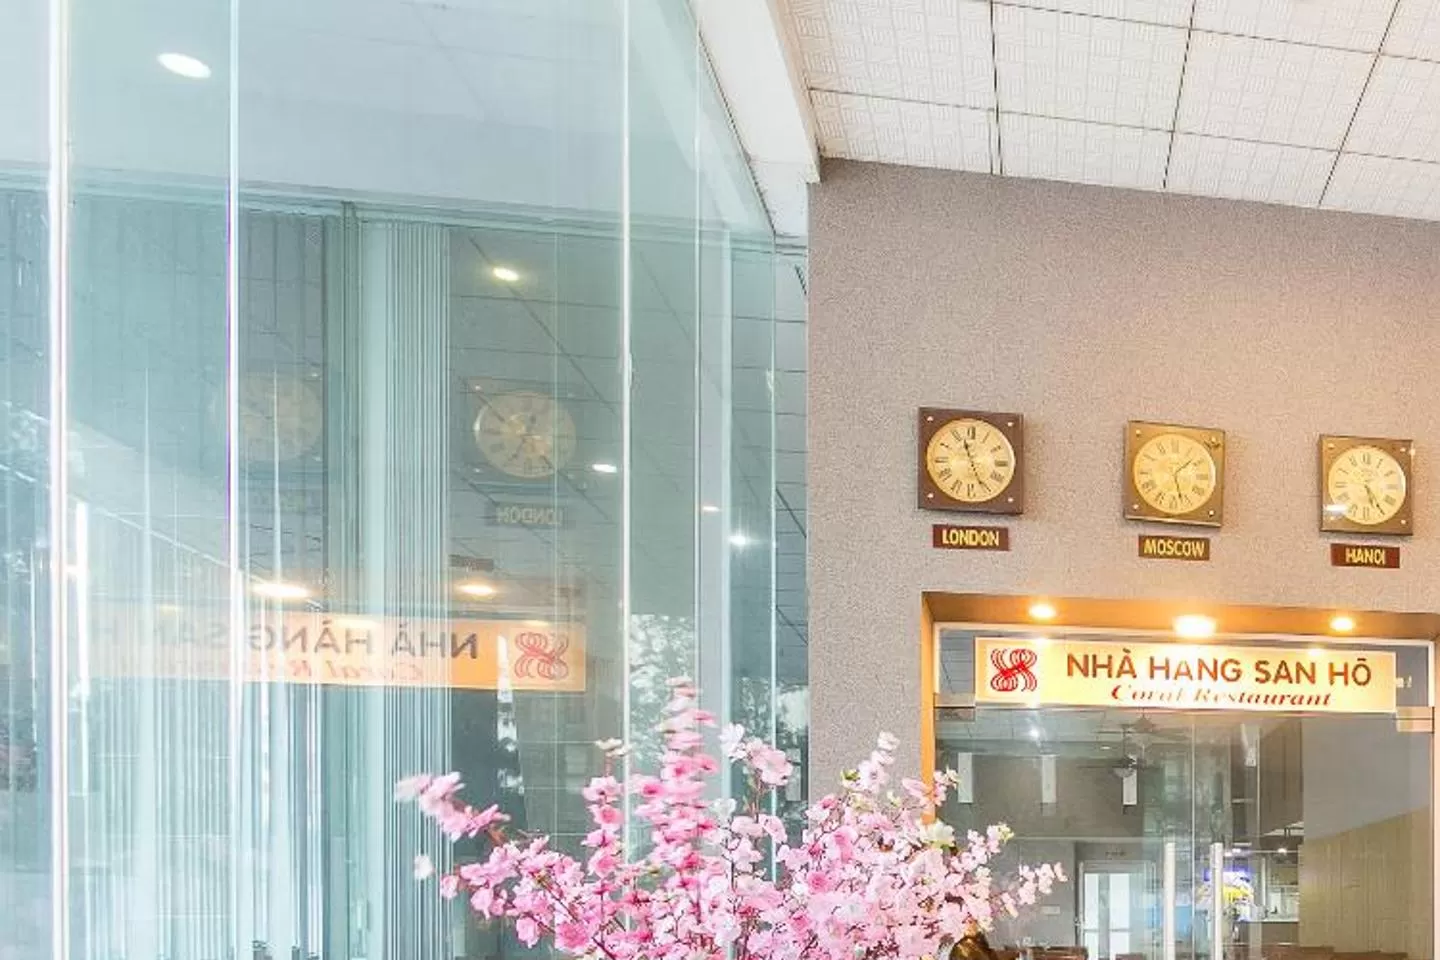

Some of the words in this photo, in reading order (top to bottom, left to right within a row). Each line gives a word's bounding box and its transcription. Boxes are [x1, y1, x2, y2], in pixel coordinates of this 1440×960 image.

[942, 529, 1000, 546] LONDON
[1143, 538, 1205, 558] MOSCOW
[1345, 547, 1385, 565] HANOI
[1066, 648, 1138, 679] NHÀ
[1255, 659, 1316, 685] SAN
[1194, 688, 1332, 706] Restaurant
